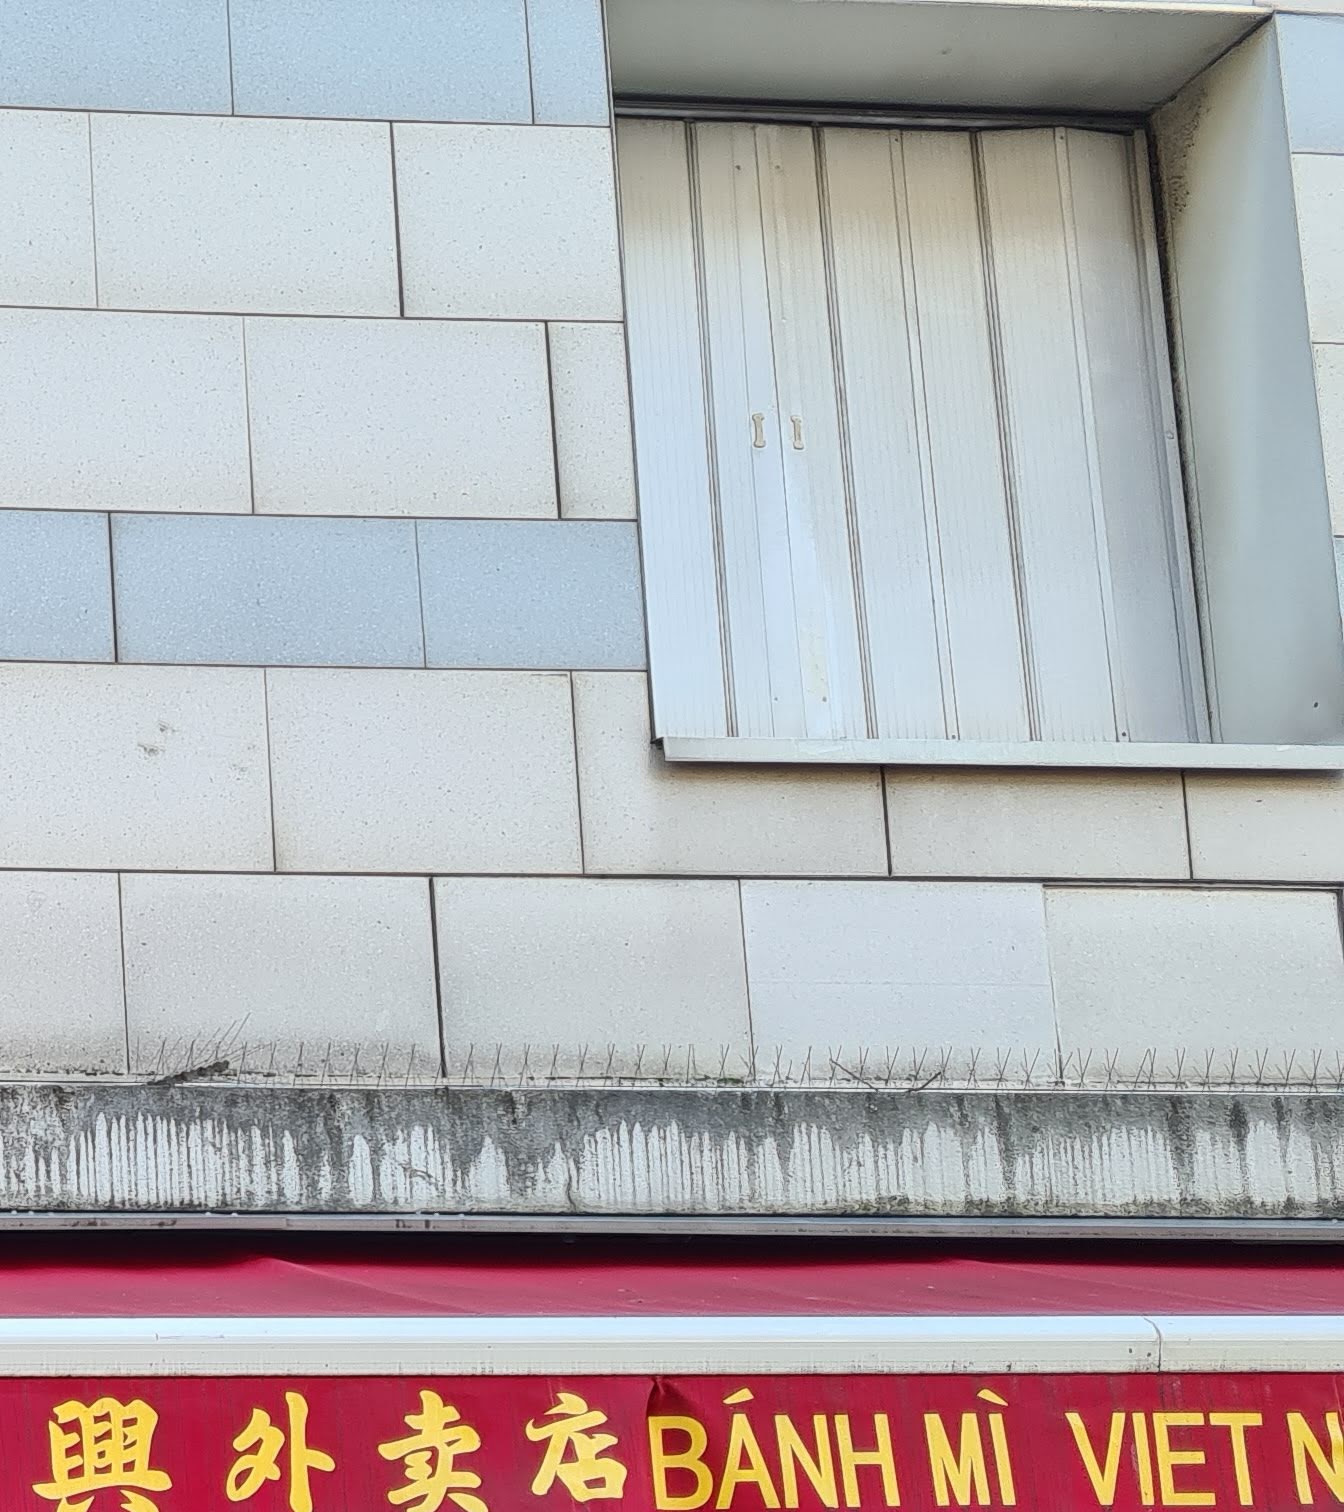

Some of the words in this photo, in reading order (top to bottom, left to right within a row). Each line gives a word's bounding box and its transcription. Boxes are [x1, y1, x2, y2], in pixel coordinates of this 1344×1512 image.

[648, 1387, 900, 1510] BÁNH
[924, 1387, 1016, 1508] MÌ
[1065, 1411, 1262, 1506] VIET
